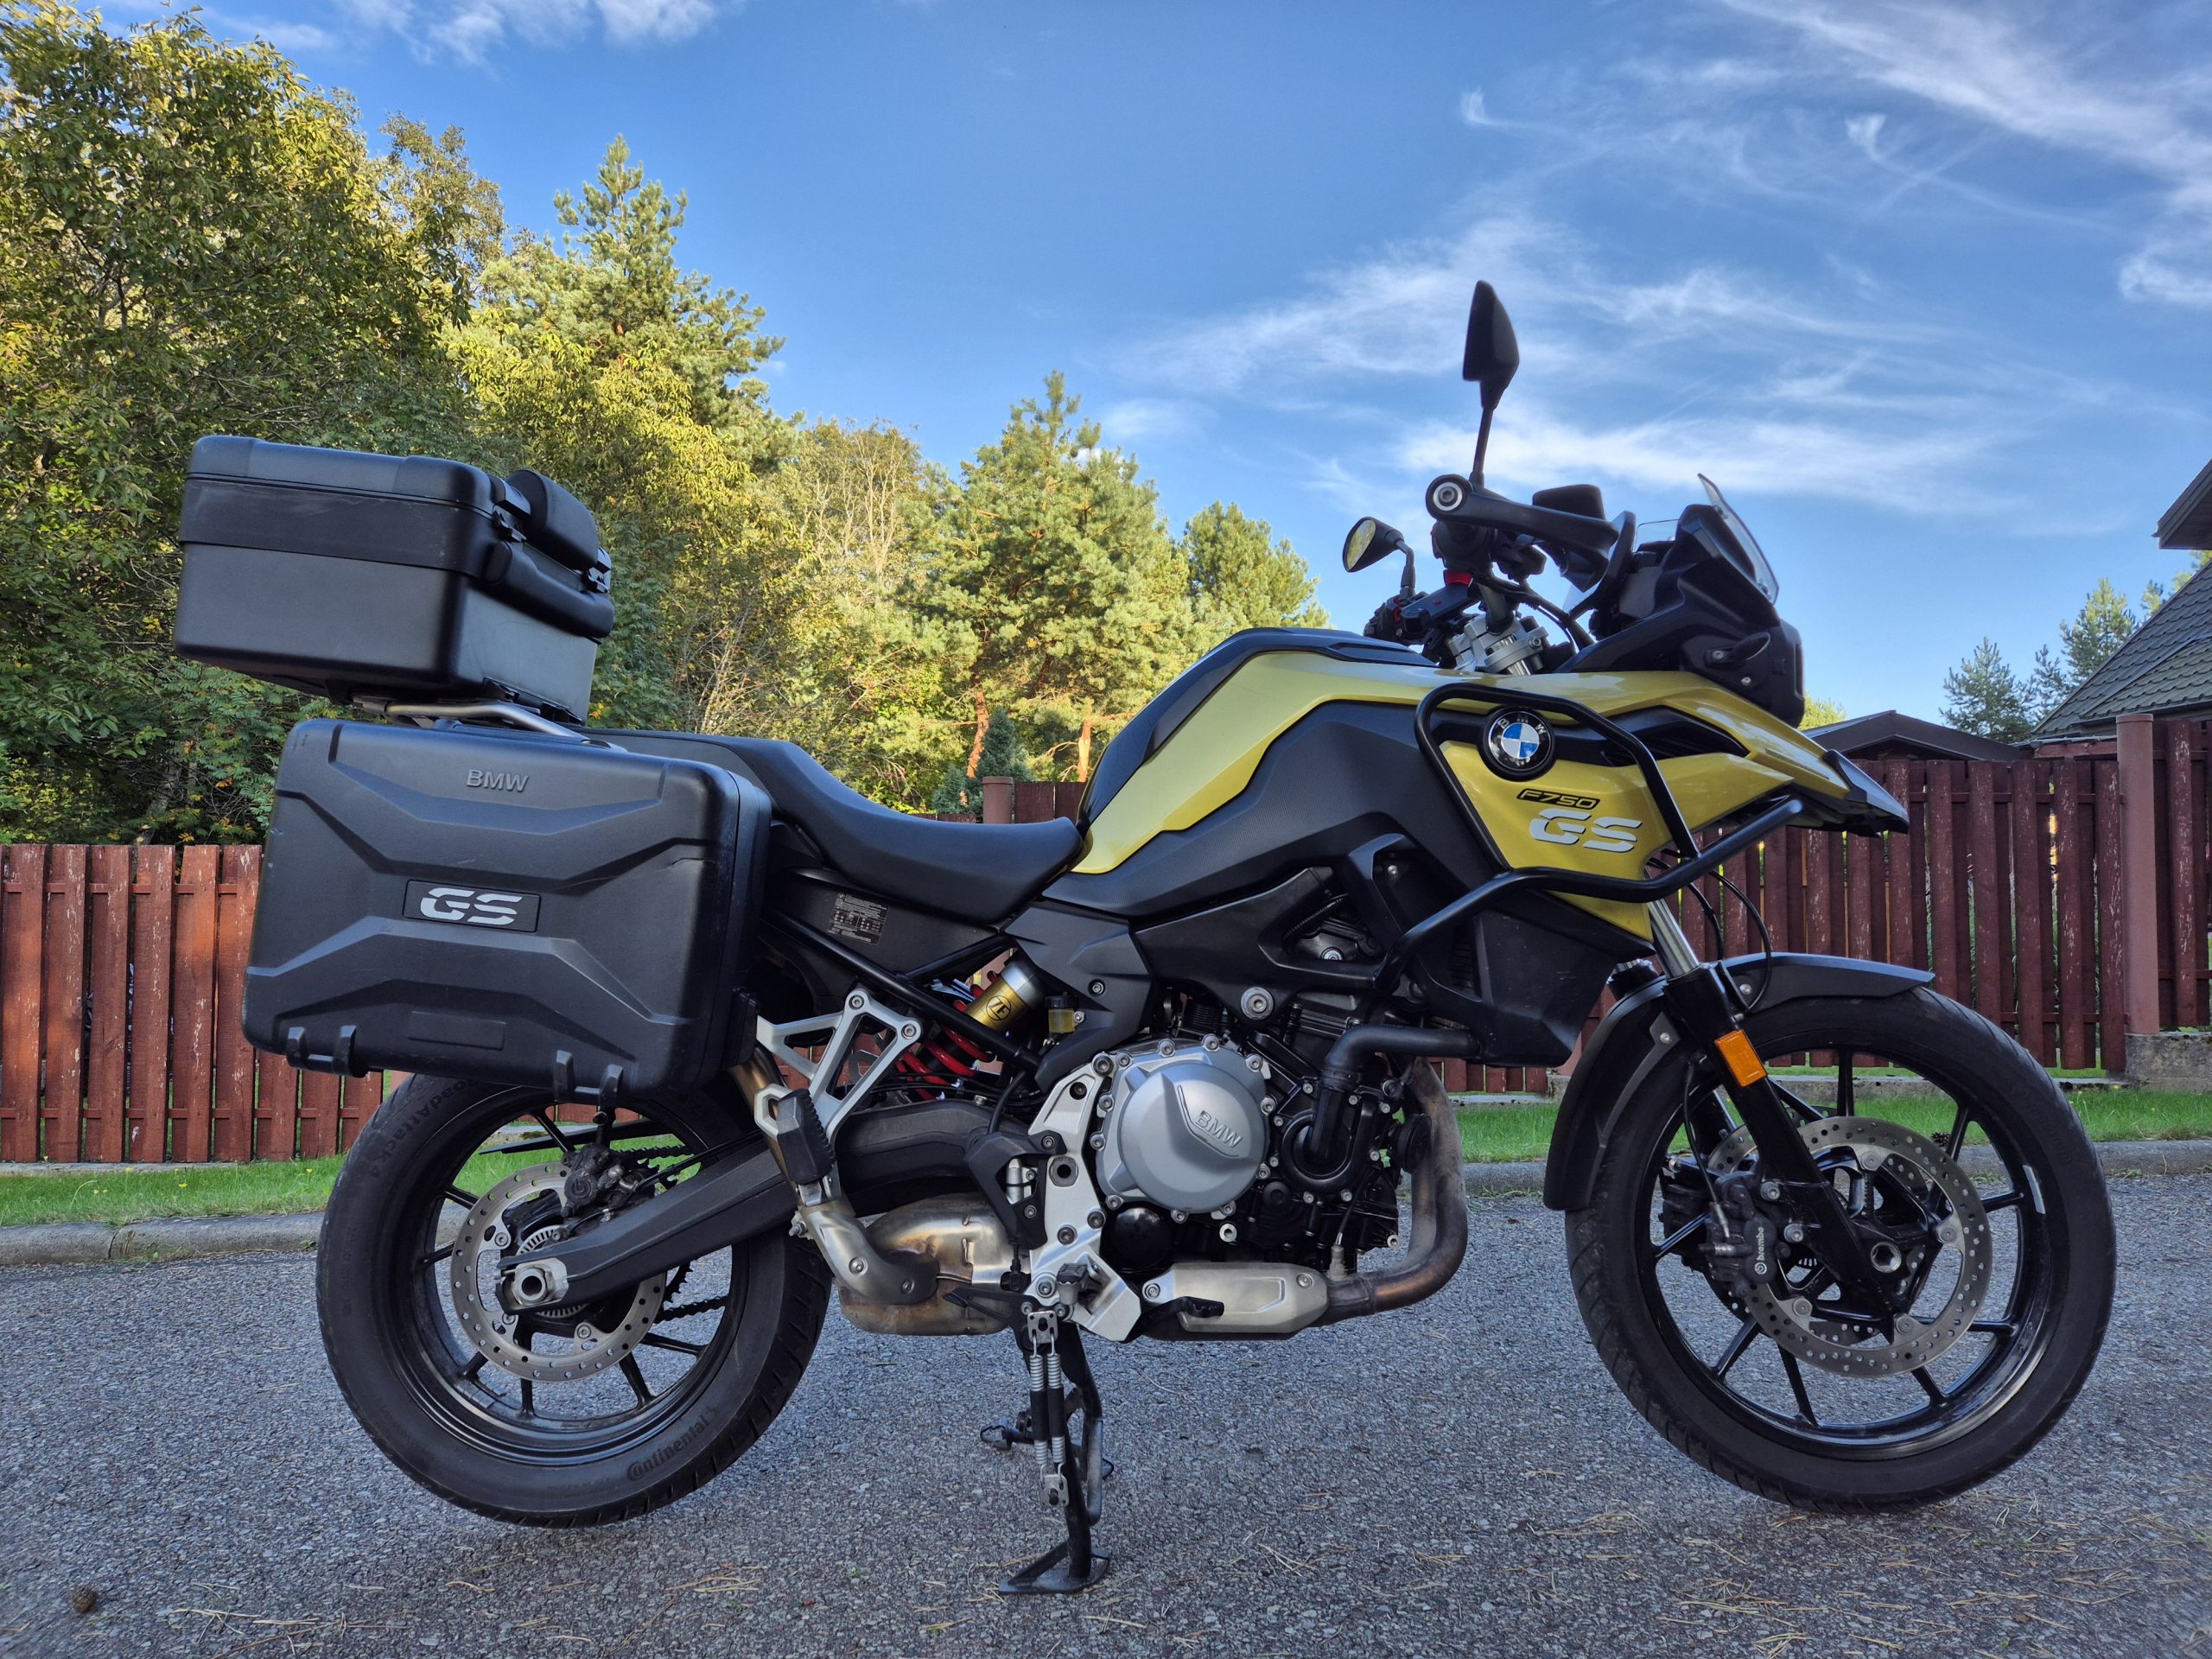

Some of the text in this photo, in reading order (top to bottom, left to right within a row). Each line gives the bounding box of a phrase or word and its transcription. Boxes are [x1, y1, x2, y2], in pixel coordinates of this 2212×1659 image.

[1497, 713, 1547, 735] BMW
[467, 769, 529, 792] BMW
[1519, 790, 1599, 810] F750
[1529, 809, 1643, 853] GS
[420, 887, 523, 925] GS
[989, 995, 1008, 1020] ZF
[1196, 1109, 1243, 1148] BMW
[1756, 1227, 1764, 1261] brembo
[626, 1414, 710, 1482] Continental
